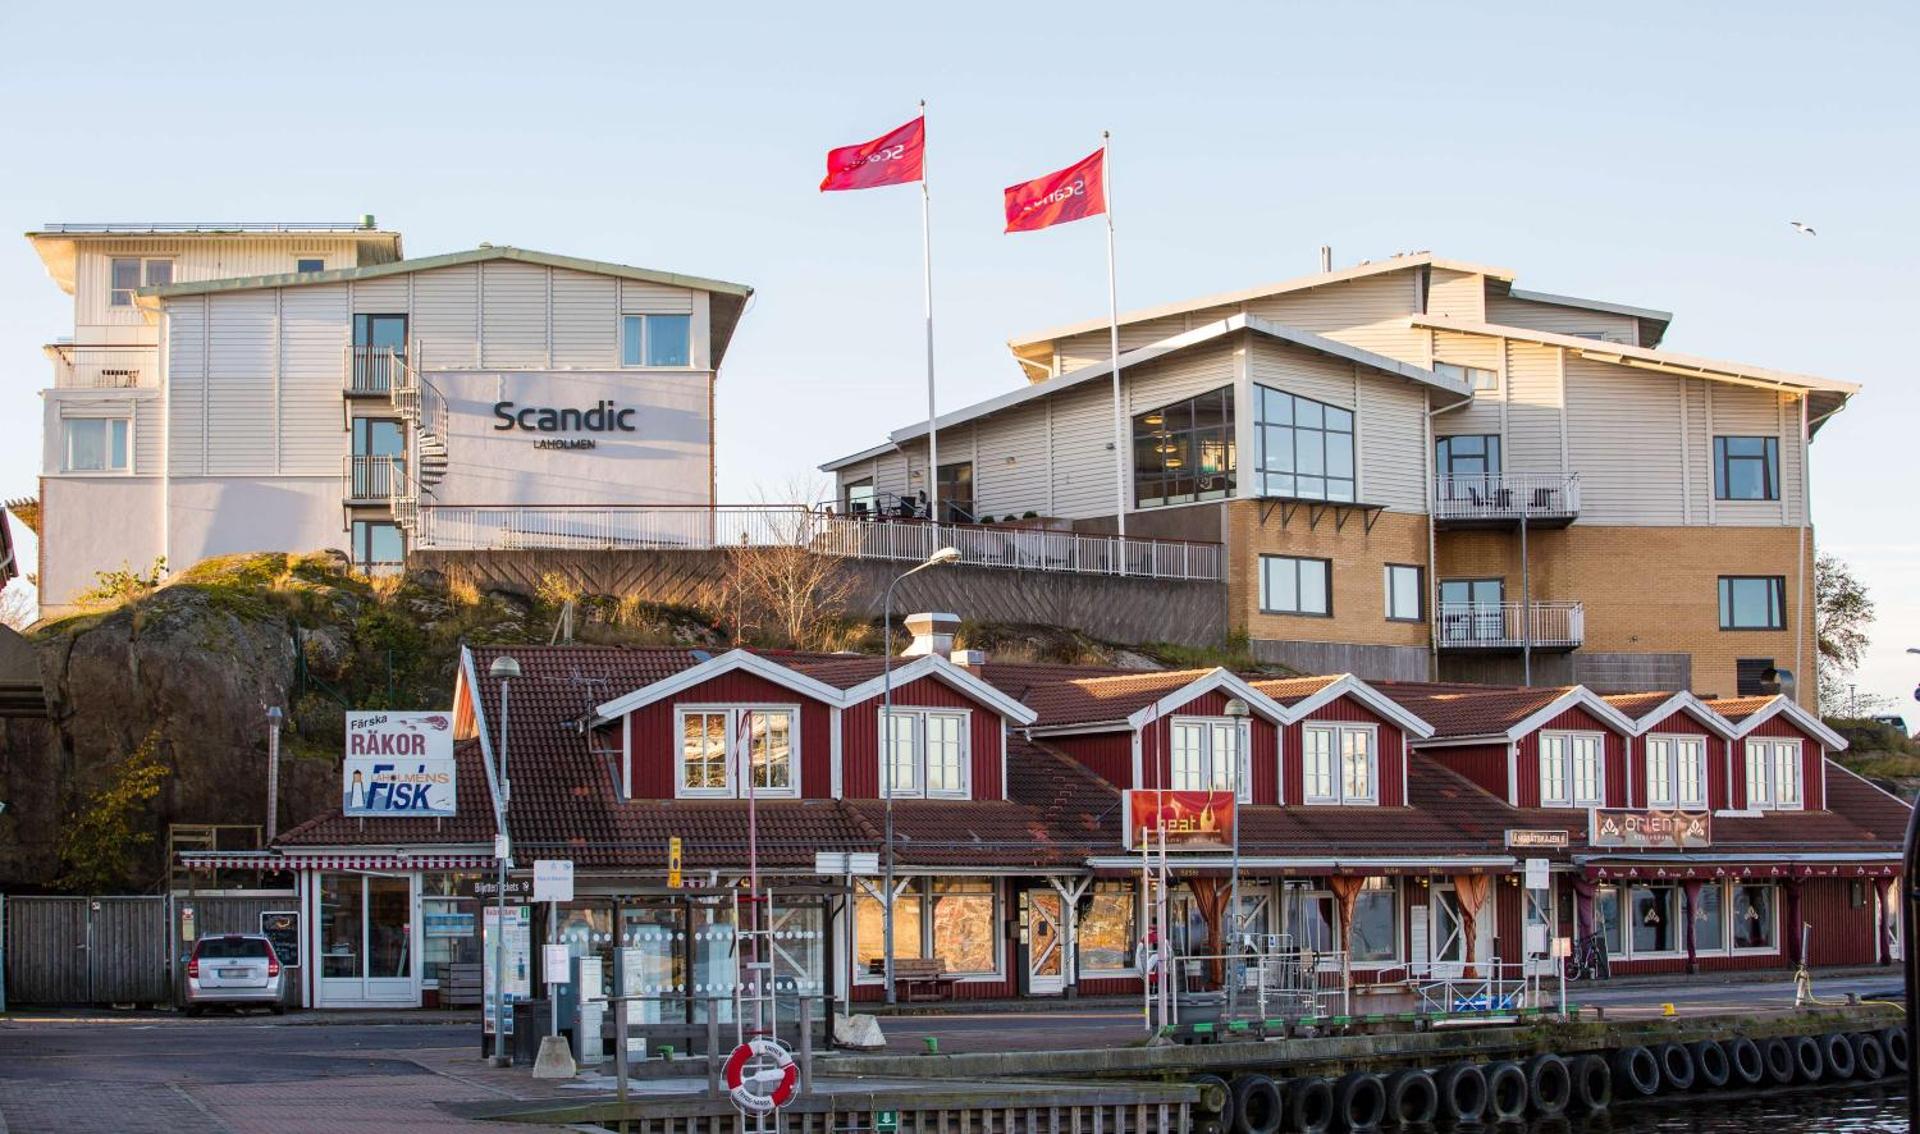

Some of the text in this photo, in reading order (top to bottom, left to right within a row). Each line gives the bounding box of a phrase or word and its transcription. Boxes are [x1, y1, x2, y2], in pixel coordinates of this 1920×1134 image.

[494, 400, 636, 431] Scandic
[533, 439, 596, 450] LAHOLMEN
[350, 715, 388, 730] Färska
[351, 730, 426, 755] RÄKOR
